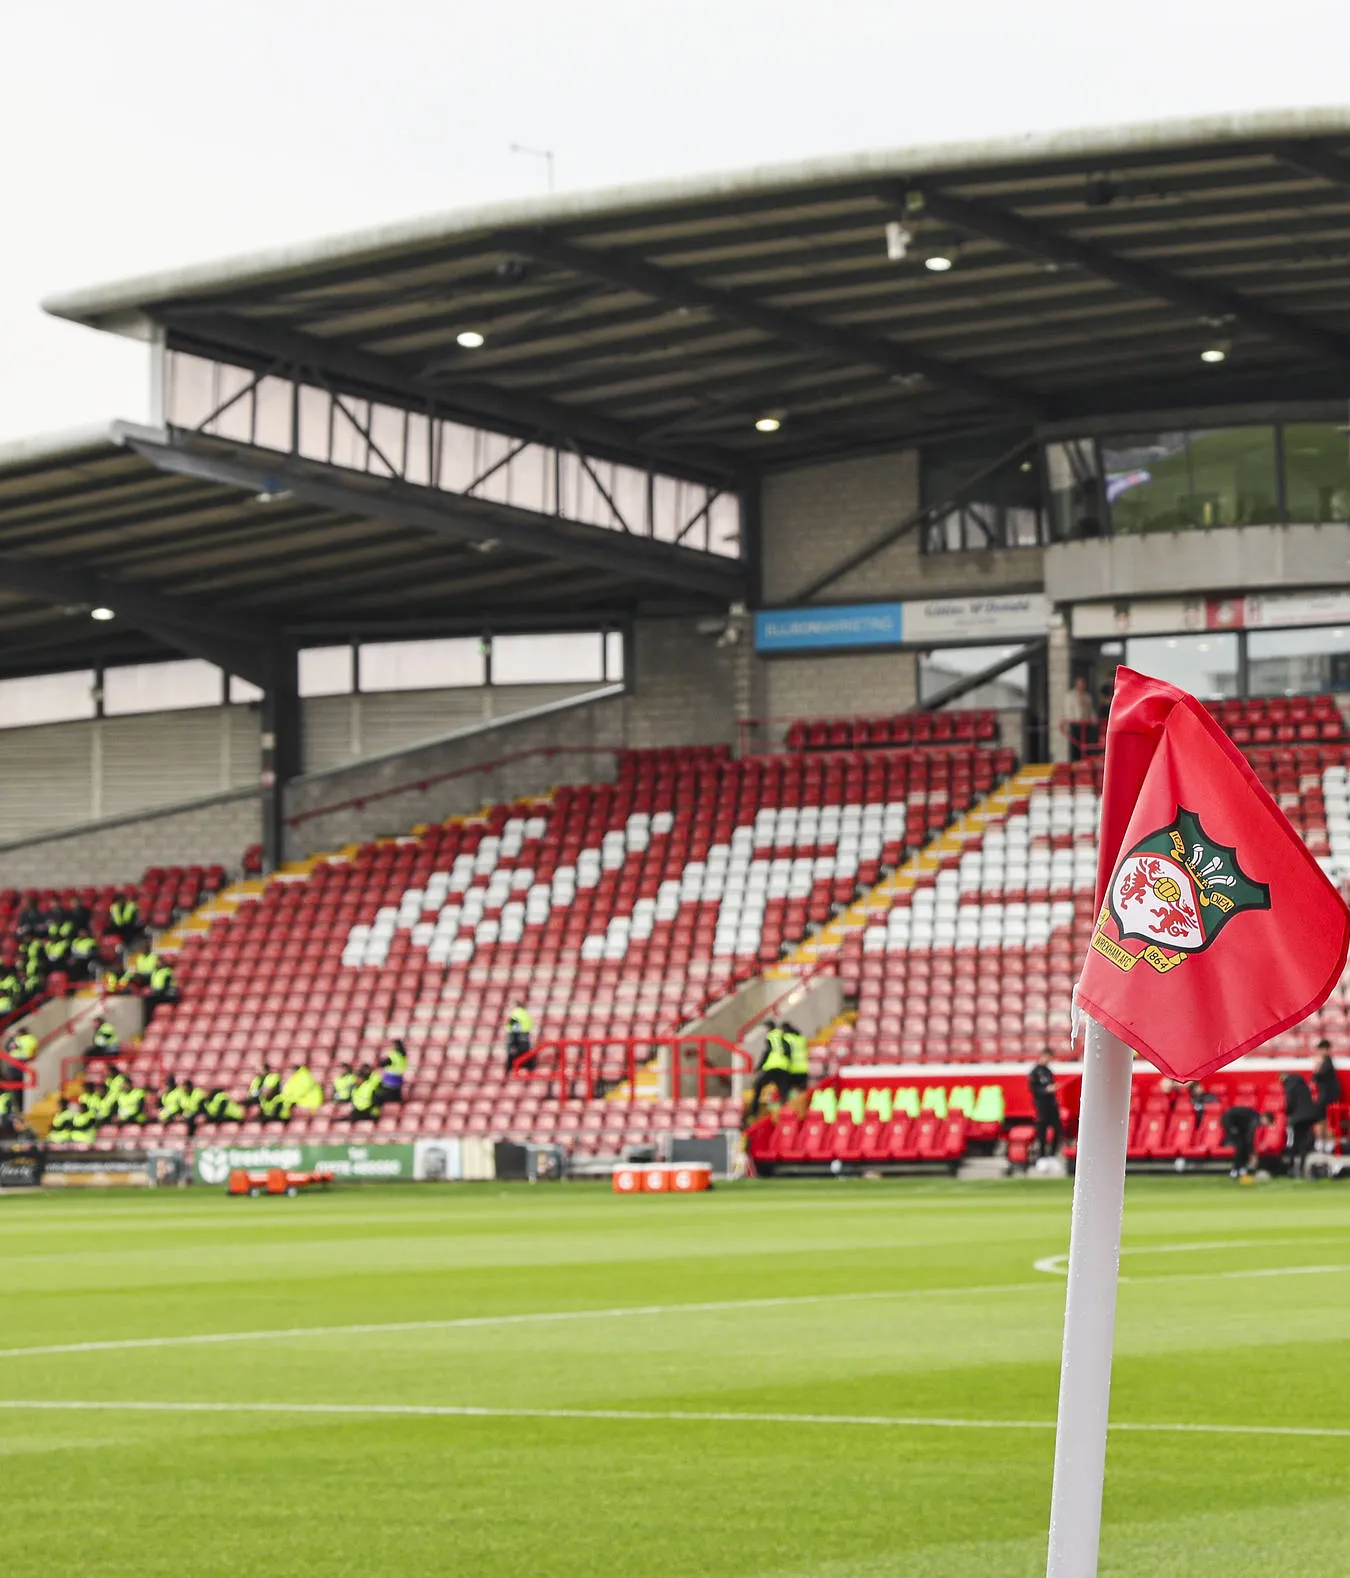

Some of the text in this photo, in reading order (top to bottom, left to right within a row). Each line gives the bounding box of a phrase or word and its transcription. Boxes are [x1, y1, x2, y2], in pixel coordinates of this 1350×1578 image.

[1211, 892, 1232, 911] DIEN
[1094, 934, 1132, 968] WREXHAM AFC
[1147, 949, 1169, 969] 1864
